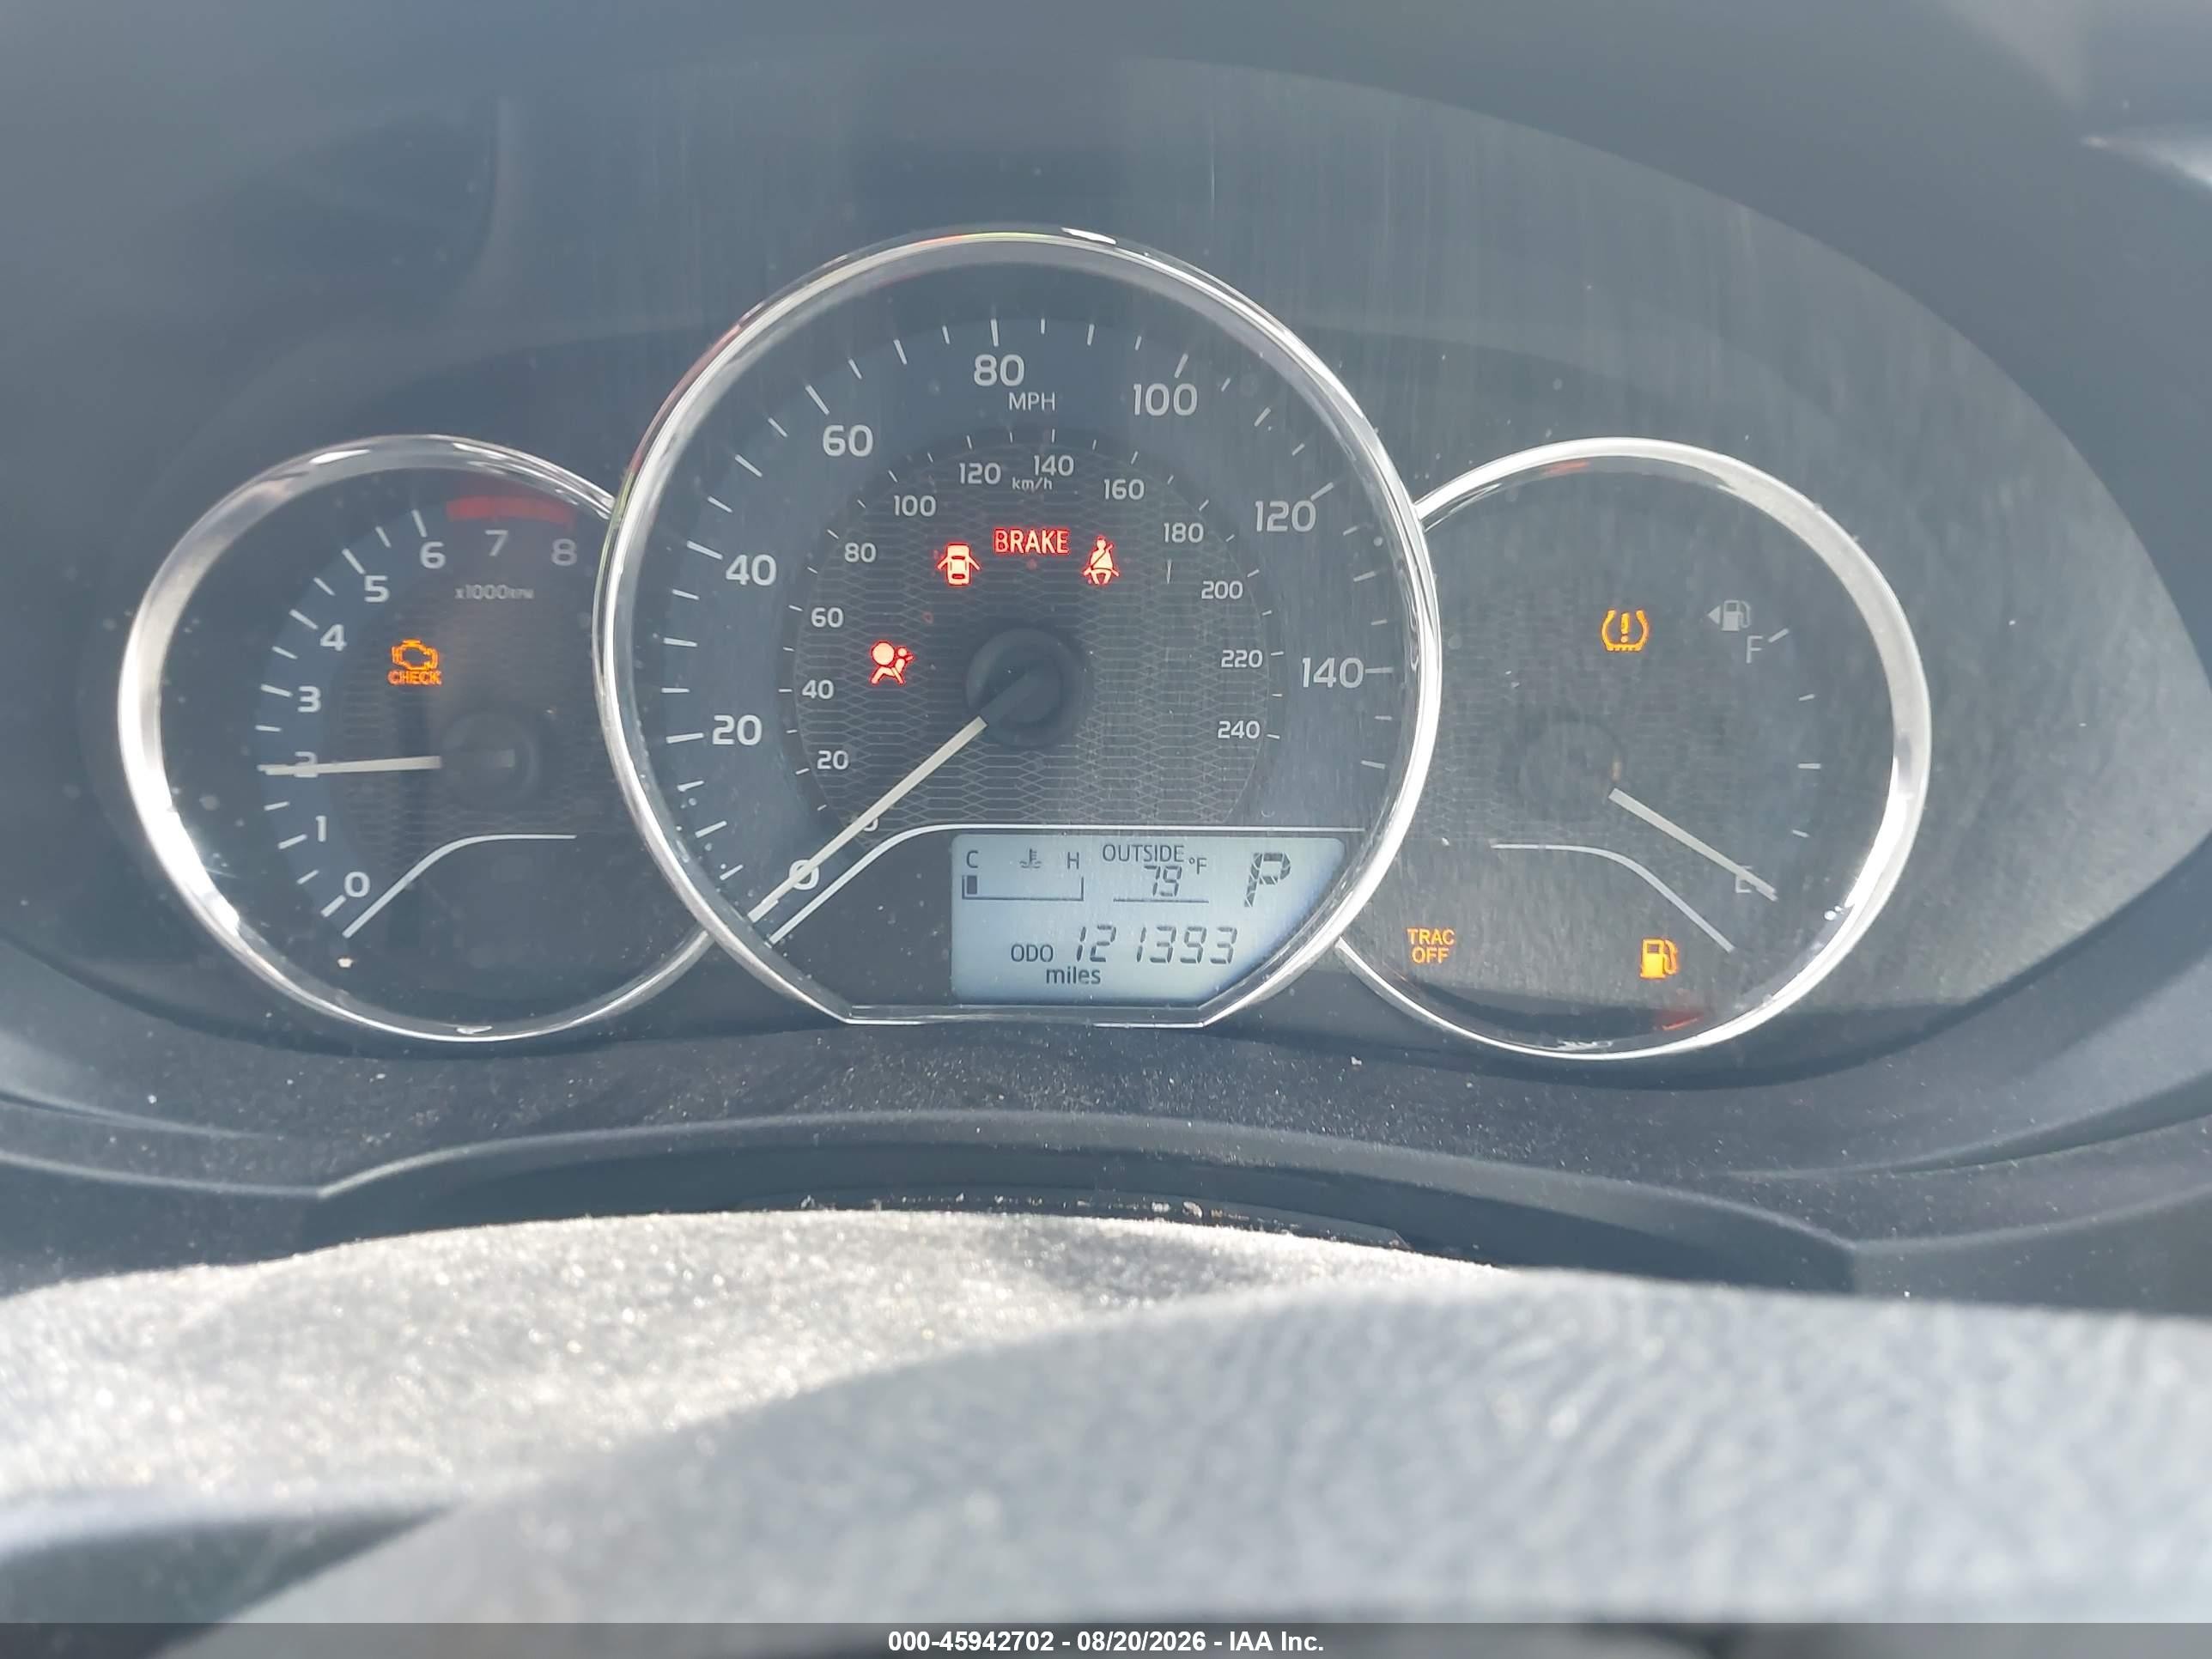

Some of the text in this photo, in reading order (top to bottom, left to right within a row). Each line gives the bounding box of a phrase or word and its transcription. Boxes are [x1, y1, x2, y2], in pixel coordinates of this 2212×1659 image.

[973, 354, 1025, 386] 80
[1008, 392, 1056, 411] MPH
[1133, 383, 1198, 416] 100
[822, 424, 873, 457] 60
[958, 462, 1002, 485] 120
[1033, 454, 1074, 477] 140
[1012, 477, 1052, 491] km/h
[1103, 478, 1146, 501] 160
[893, 495, 937, 517] 100
[1255, 500, 1316, 532] 120
[485, 529, 509, 556] 7
[994, 528, 1071, 555] BRAKE
[1164, 522, 1204, 544] 180
[420, 541, 446, 569] 6
[550, 538, 577, 567] 8
[844, 543, 877, 563] 80
[725, 555, 777, 586] 40
[364, 575, 390, 603] 5
[1201, 581, 1243, 600] 200
[811, 608, 844, 628] 60
[319, 624, 347, 652] 4
[1745, 635, 1764, 664] F
[1220, 650, 1263, 668] 220
[387, 670, 442, 686] CHECK
[1301, 658, 1364, 689] 140
[297, 686, 321, 713] 3
[802, 680, 835, 699] 40
[712, 715, 763, 745] 20
[1218, 721, 1261, 739] 240
[817, 750, 849, 770] 20
[315, 815, 327, 842] 1
[966, 851, 979, 869] C
[1067, 853, 1080, 870] H
[1103, 843, 1184, 862] OUTSIDE
[344, 872, 370, 898] 0
[1144, 866, 1182, 897] 79
[1244, 852, 1291, 908] P
[1011, 925, 1238, 964] ODO 121393
[1407, 928, 1455, 946] TRAC
[1412, 946, 1449, 964] OFF
[1046, 966, 1101, 985] miles
